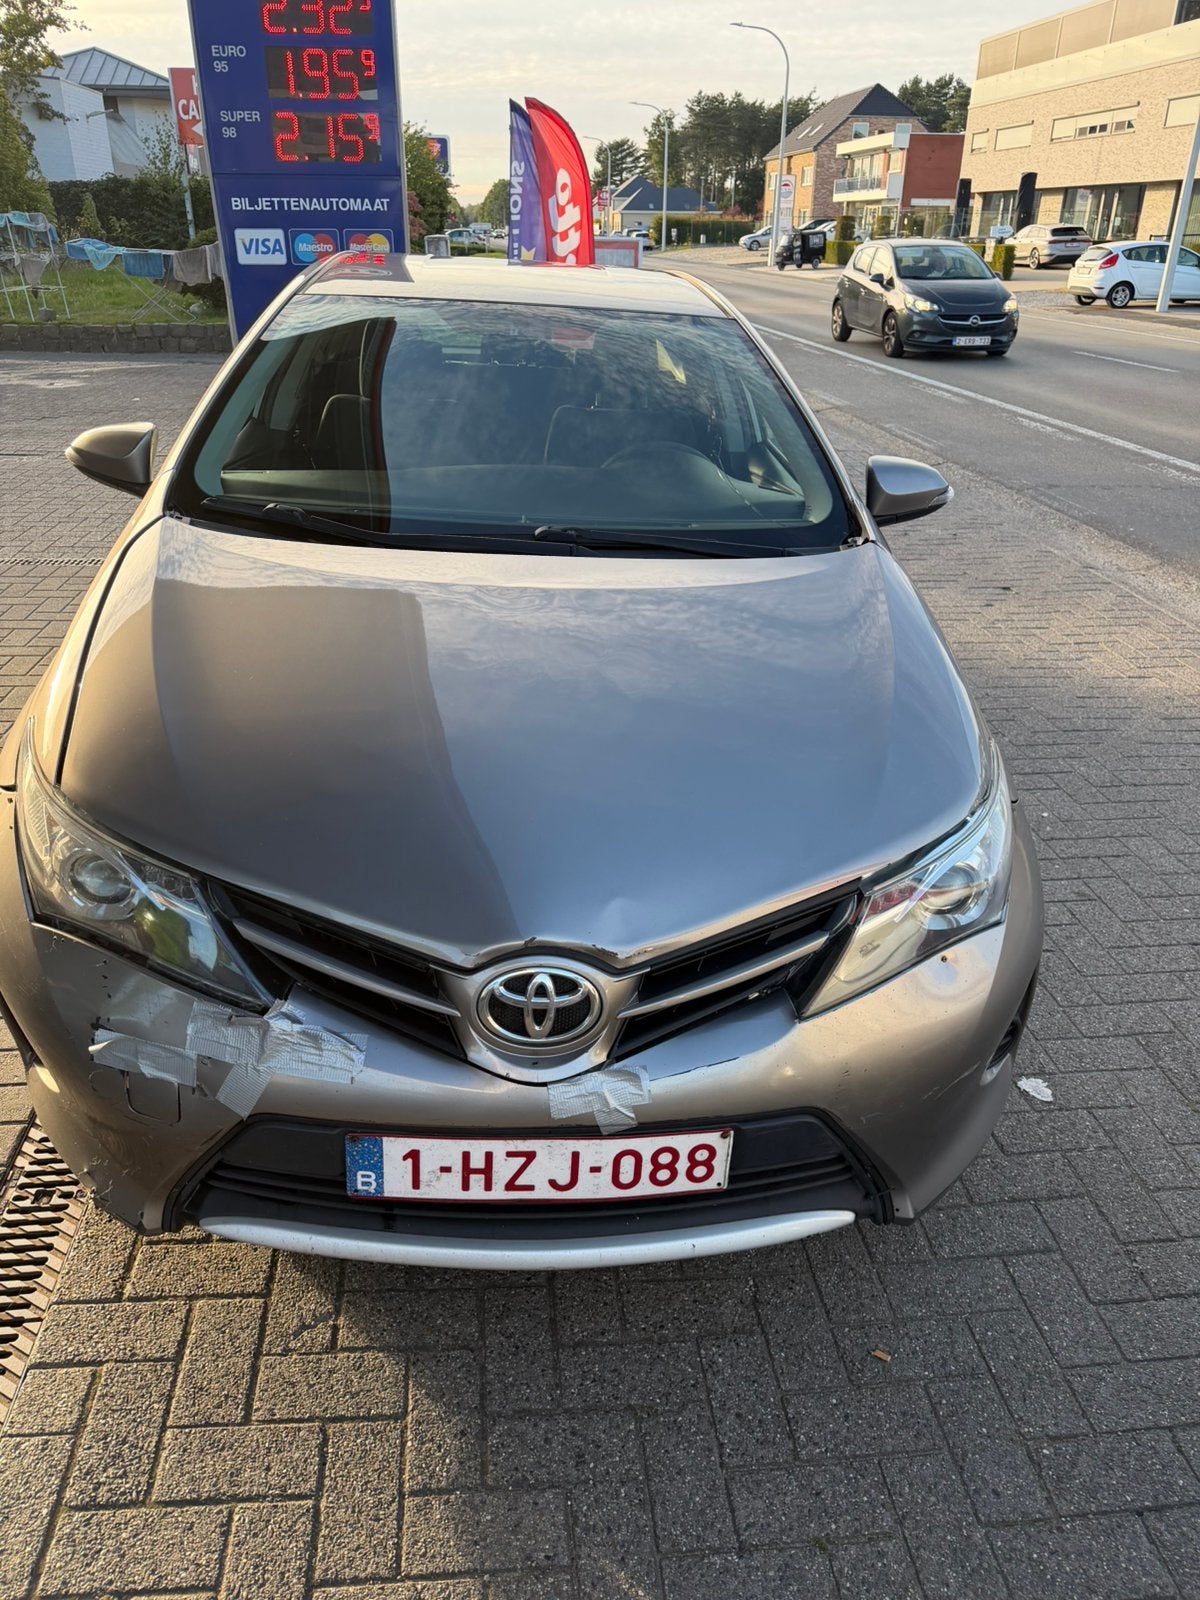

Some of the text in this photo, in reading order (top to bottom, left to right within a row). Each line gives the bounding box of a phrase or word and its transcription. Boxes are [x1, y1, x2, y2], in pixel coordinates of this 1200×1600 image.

[211, 45, 247, 57] EURO
[213, 60, 229, 73] 95
[178, 98, 202, 120] CA
[220, 110, 261, 122] SUPER
[222, 127, 237, 138] 98
[231, 197, 390, 212] BILJETTENAUTOMAAT
[238, 238, 285, 255] VISA
[298, 242, 334, 253] Maestro
[349, 242, 389, 252] MasterCard
[401, 1143, 718, 1193] 1-HZJ-088
[356, 1170, 378, 1193] B
